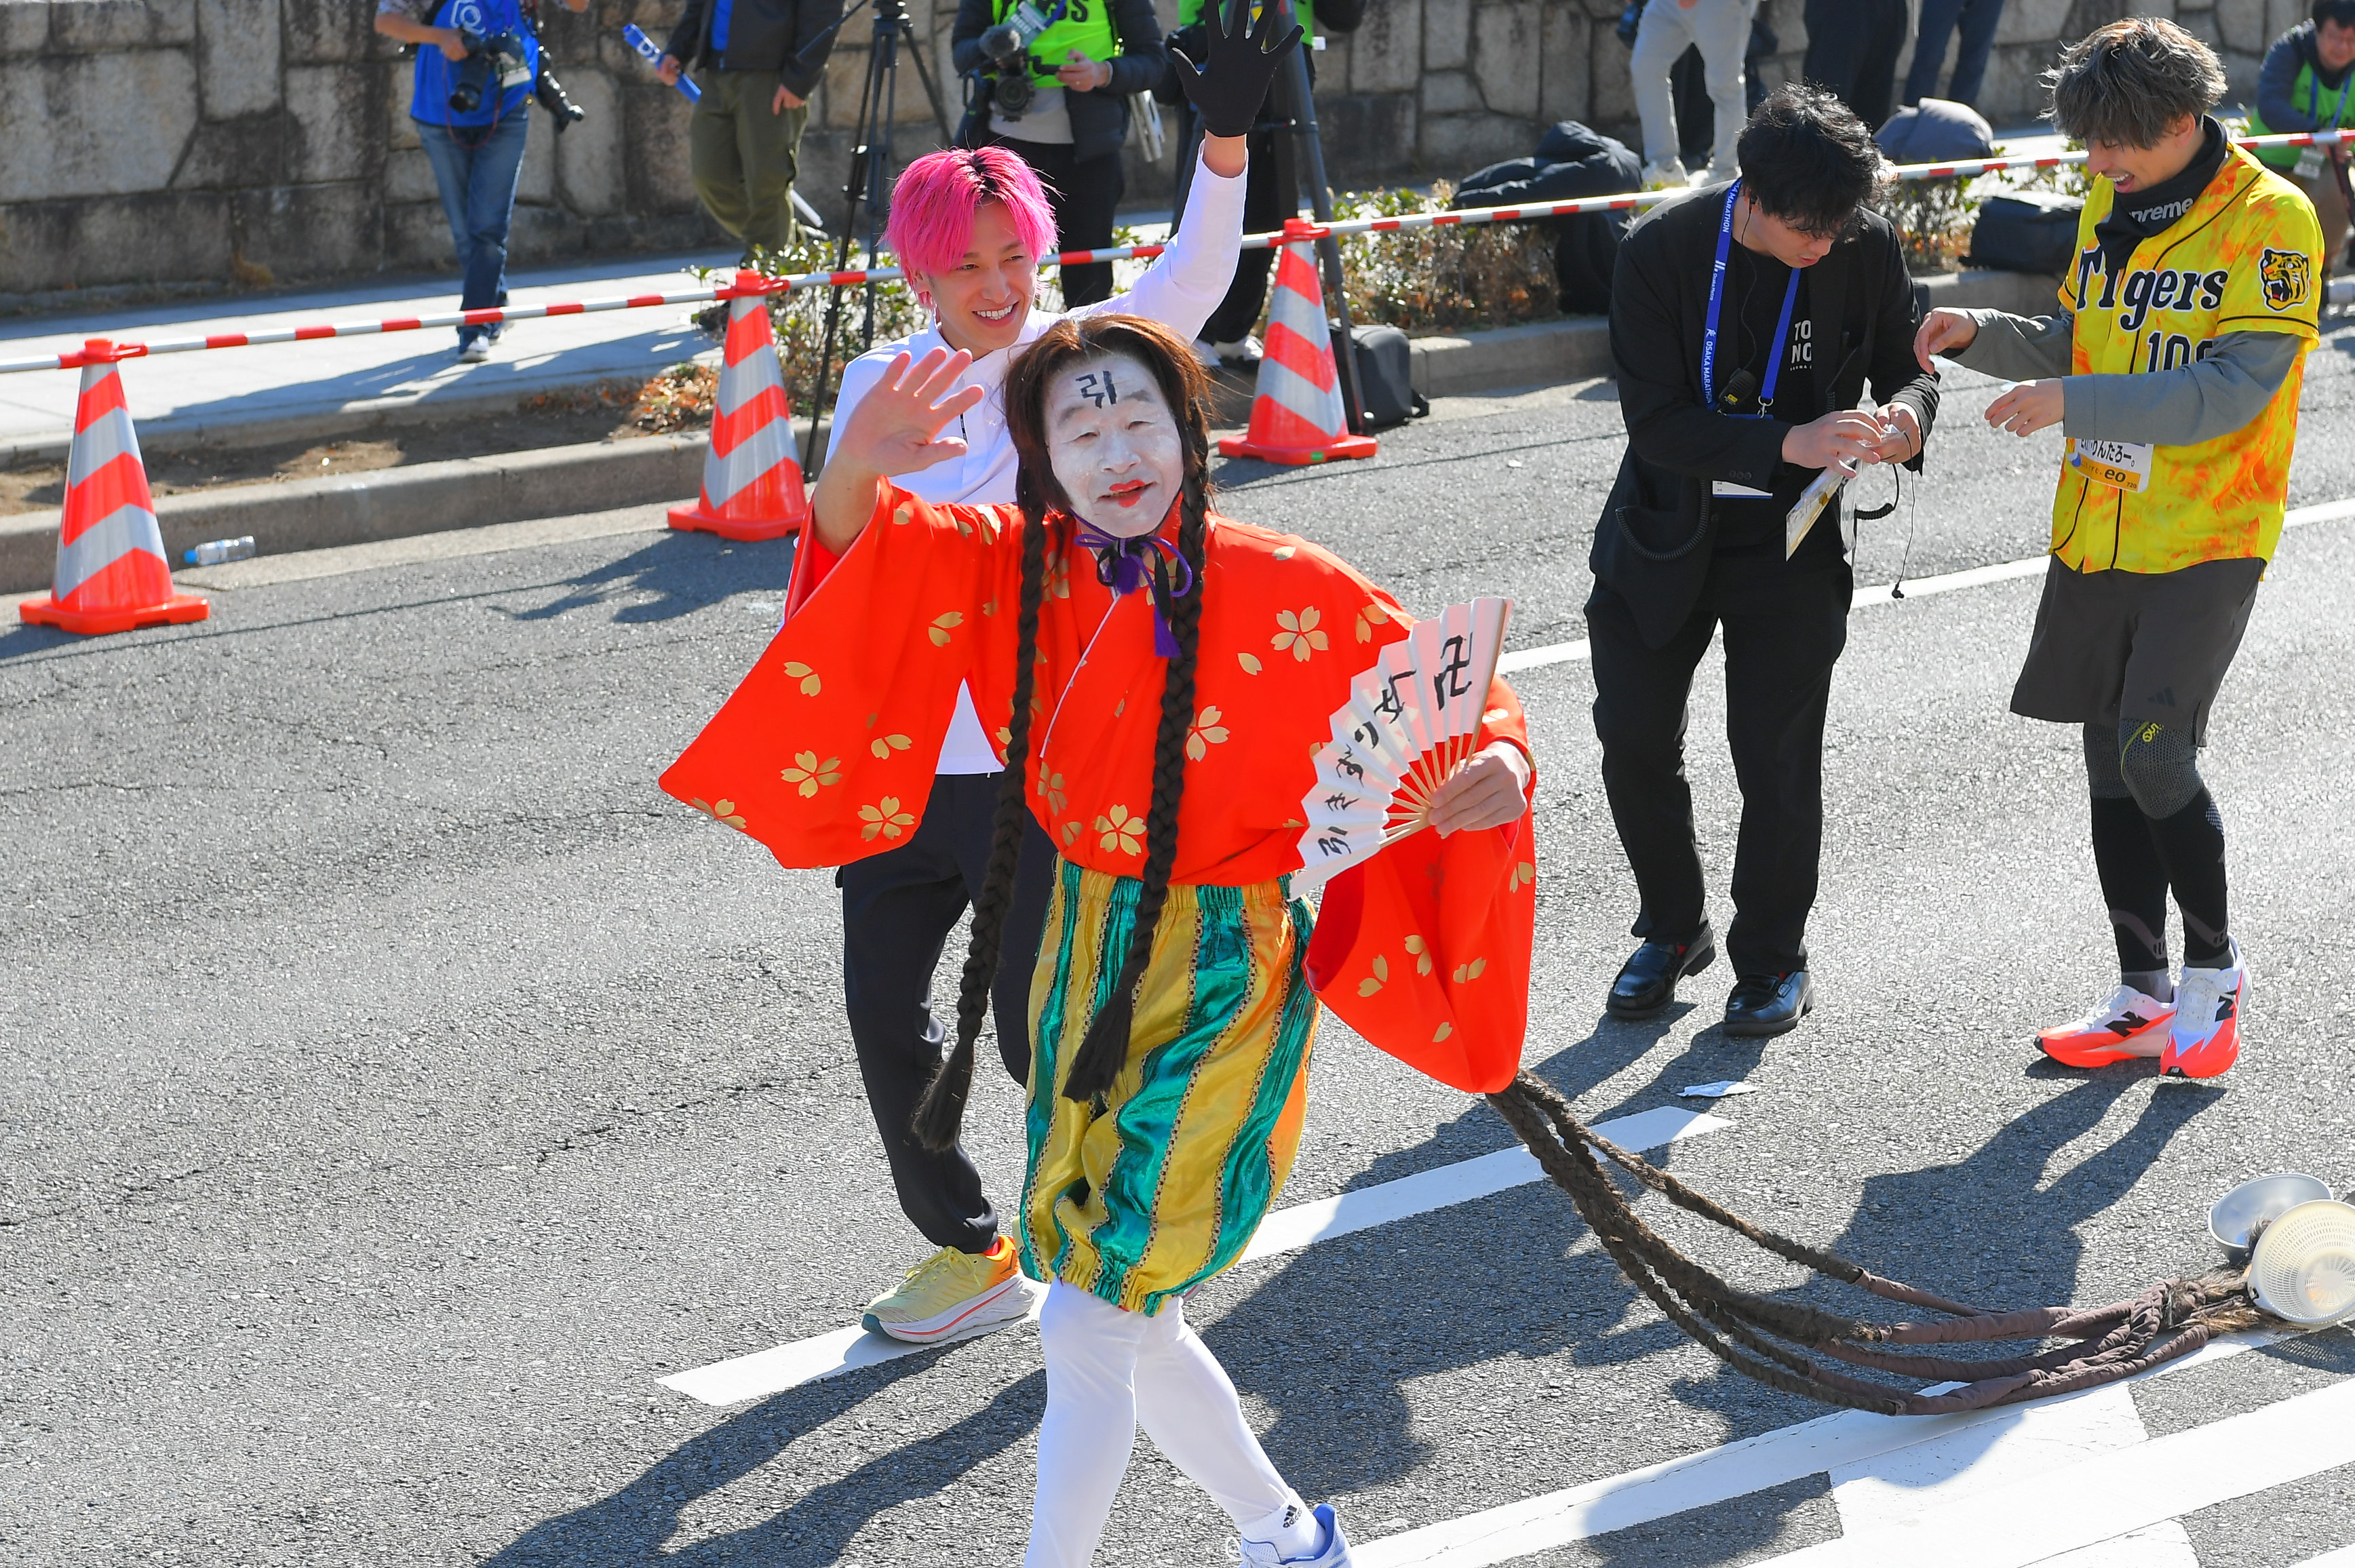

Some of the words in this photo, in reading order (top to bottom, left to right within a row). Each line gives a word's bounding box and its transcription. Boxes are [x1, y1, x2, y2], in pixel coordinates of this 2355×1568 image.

[1722, 192, 1736, 233] MARATHON
[2076, 246, 2229, 332] Tigers
[1794, 319, 1812, 341] TO
[1703, 340, 1713, 366] OSAKA
[1075, 370, 1118, 410] 引
[1703, 367, 1713, 404] MARATHON
[2104, 468, 2126, 483] eo
[1282, 1507, 1302, 1528] adidas
